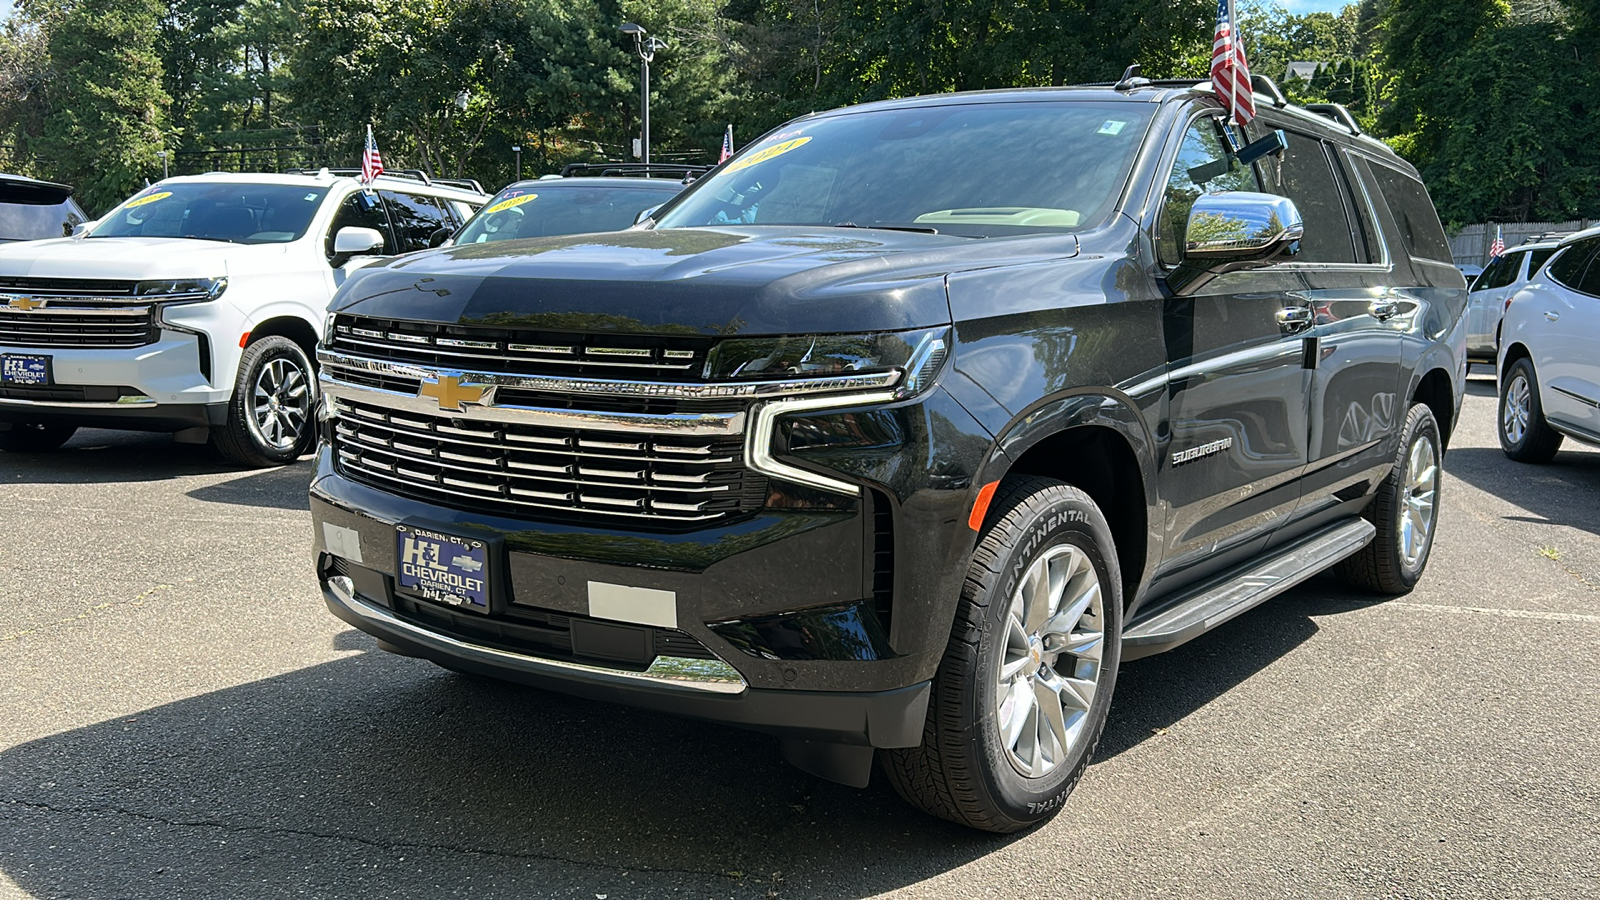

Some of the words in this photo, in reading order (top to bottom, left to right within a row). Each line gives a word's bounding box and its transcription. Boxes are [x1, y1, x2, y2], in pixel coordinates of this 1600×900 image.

[503, 190, 524, 198] LT
[4, 370, 45, 378] CHEVROLET
[1172, 437, 1232, 465] SUBURBAN
[402, 537, 448, 571] H&L
[996, 509, 1092, 623] CONTINENTAL
[402, 563, 483, 592] CHEVROLET
[455, 587, 467, 595] CT
